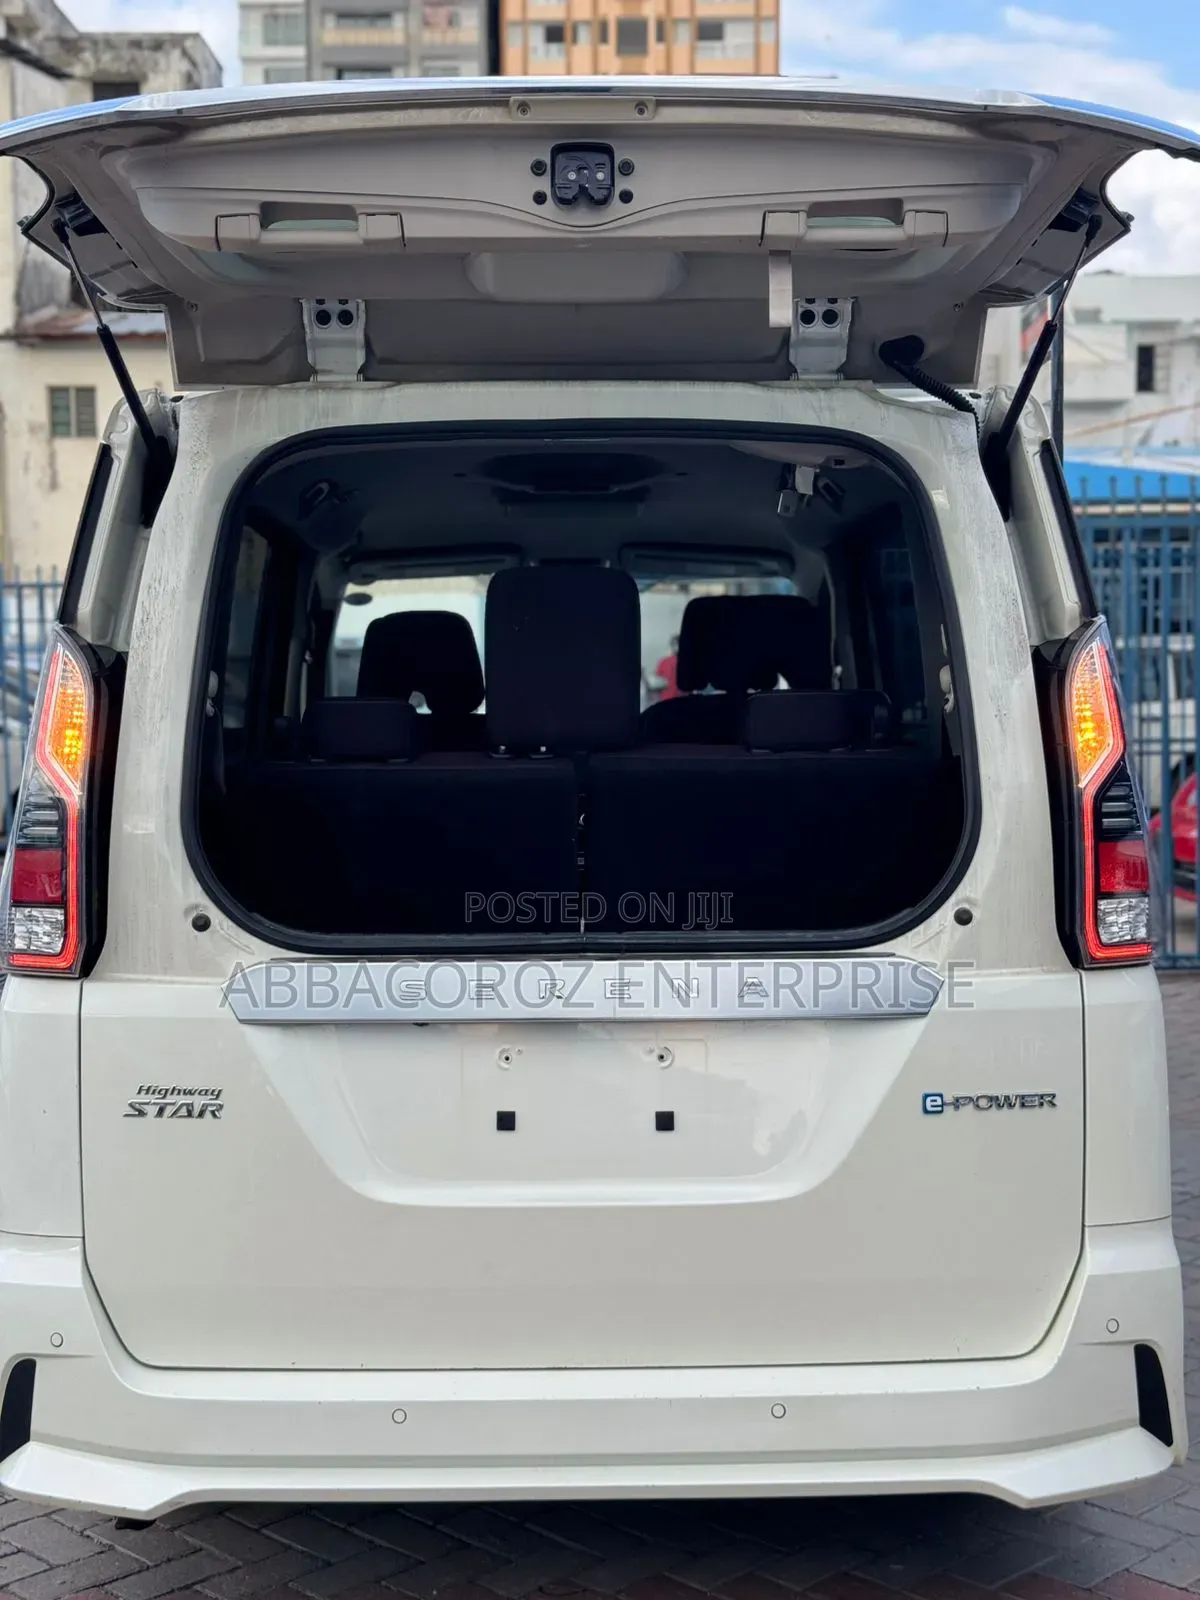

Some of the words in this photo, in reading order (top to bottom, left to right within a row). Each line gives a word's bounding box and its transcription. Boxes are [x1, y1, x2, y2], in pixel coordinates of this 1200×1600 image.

[399, 976, 769, 1001] SERENA
[136, 1083, 223, 1100] Highway
[122, 1099, 224, 1120] STAR
[922, 1092, 1057, 1114] e-POWER
